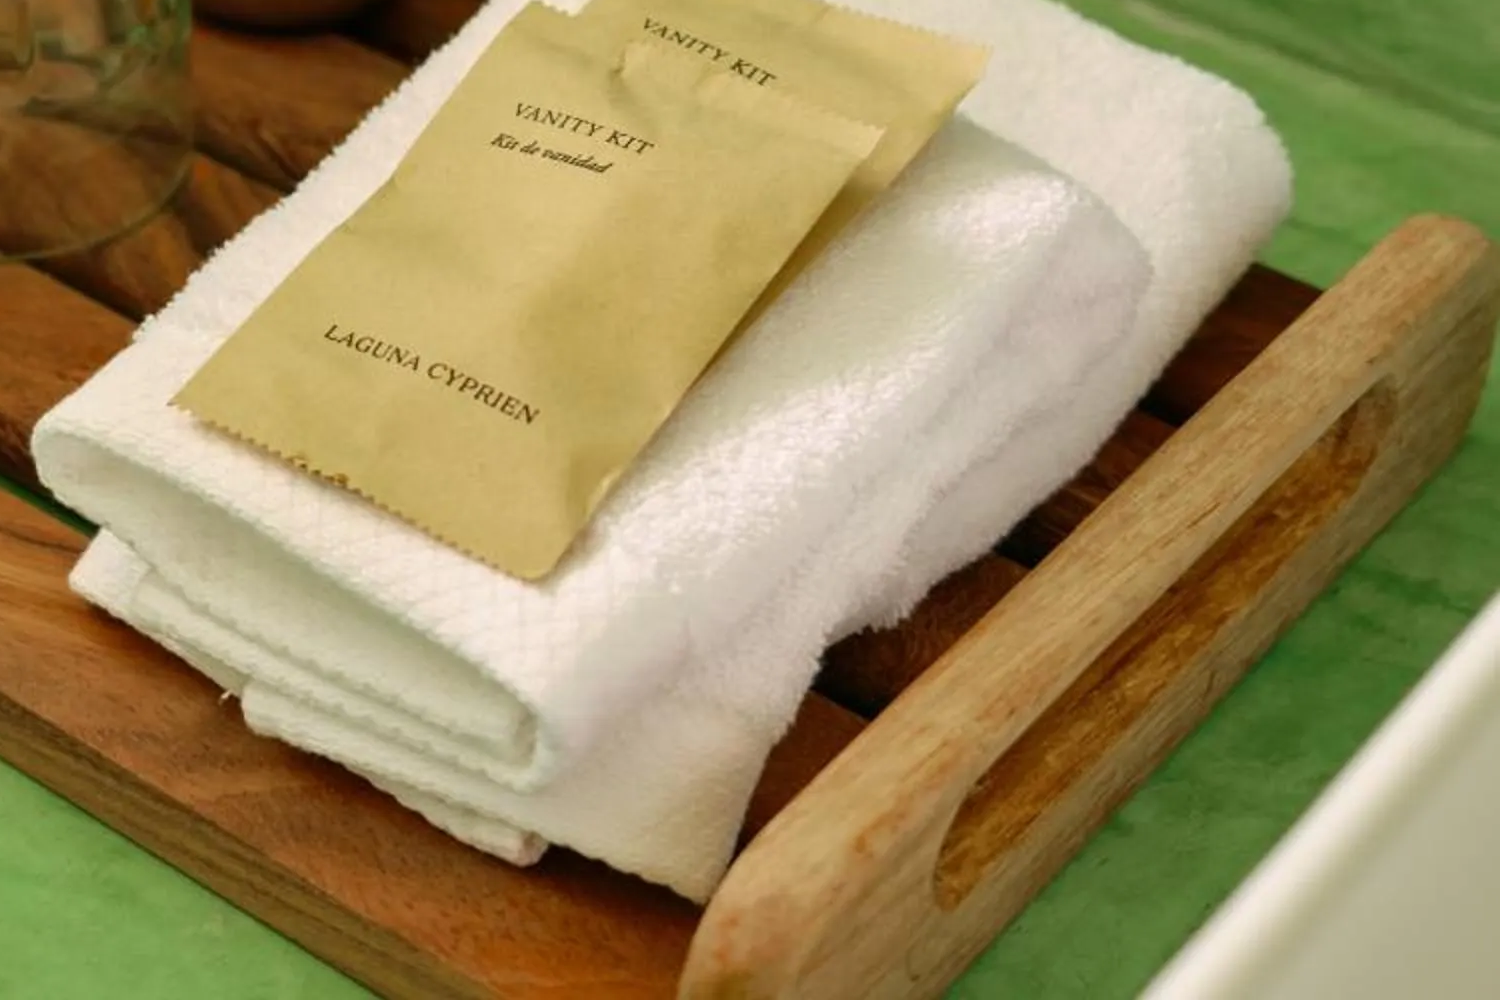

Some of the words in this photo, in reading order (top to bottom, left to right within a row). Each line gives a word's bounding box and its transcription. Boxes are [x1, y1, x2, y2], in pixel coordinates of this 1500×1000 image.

[642, 17, 730, 62] VANITY
[729, 57, 778, 87] KIT
[490, 132, 519, 152] Kit
[519, 141, 541, 156] de
[541, 149, 614, 175] vanidad
[514, 102, 605, 138] VANITY
[604, 129, 656, 155] KIT
[323, 324, 422, 372] LAGUNA
[426, 362, 541, 425] CYPRIEN
